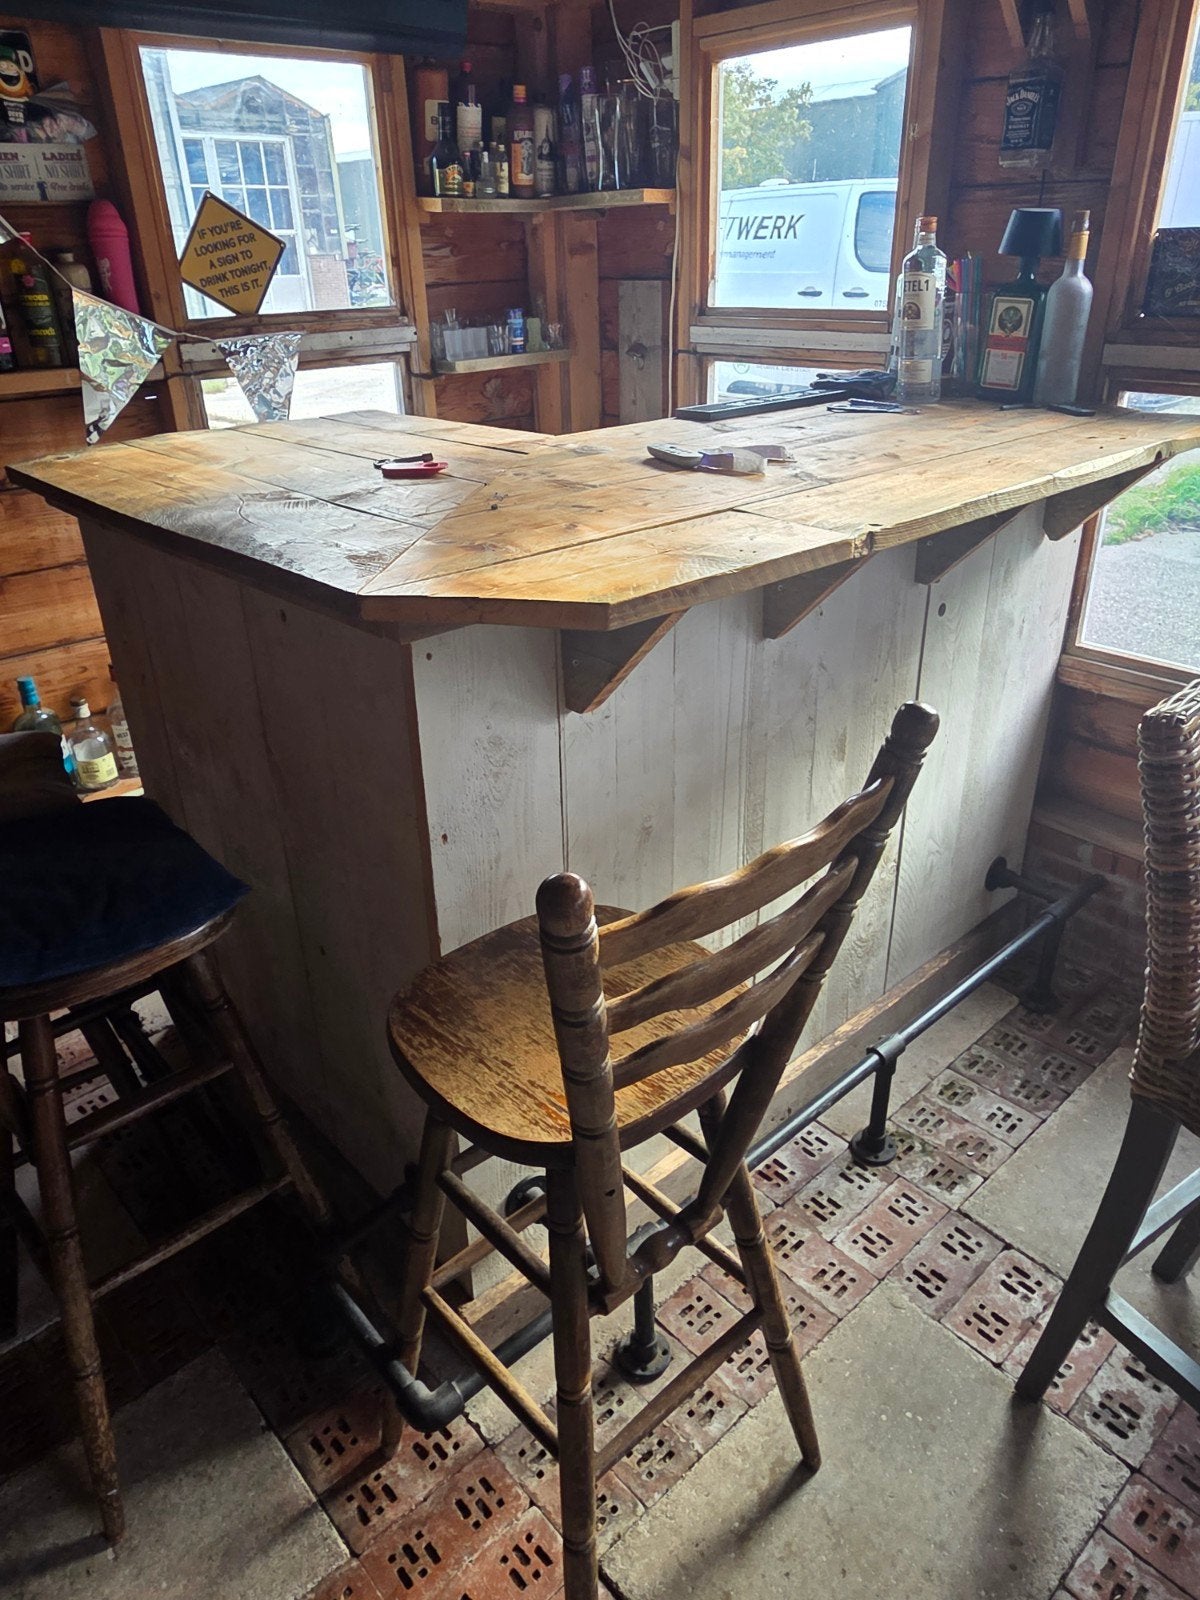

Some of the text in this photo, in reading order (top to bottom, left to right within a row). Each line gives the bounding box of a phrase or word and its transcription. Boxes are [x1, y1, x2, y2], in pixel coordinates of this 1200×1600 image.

[197, 228, 207, 240] IF
[720, 214, 805, 241] TWERK
[194, 232, 257, 257] LOOKING FOR
[209, 249, 253, 270] A SIGN TO
[199, 271, 229, 288] DRINK
[218, 278, 262, 298] THIS IS IT.
[903, 280, 923, 292] ETEL
